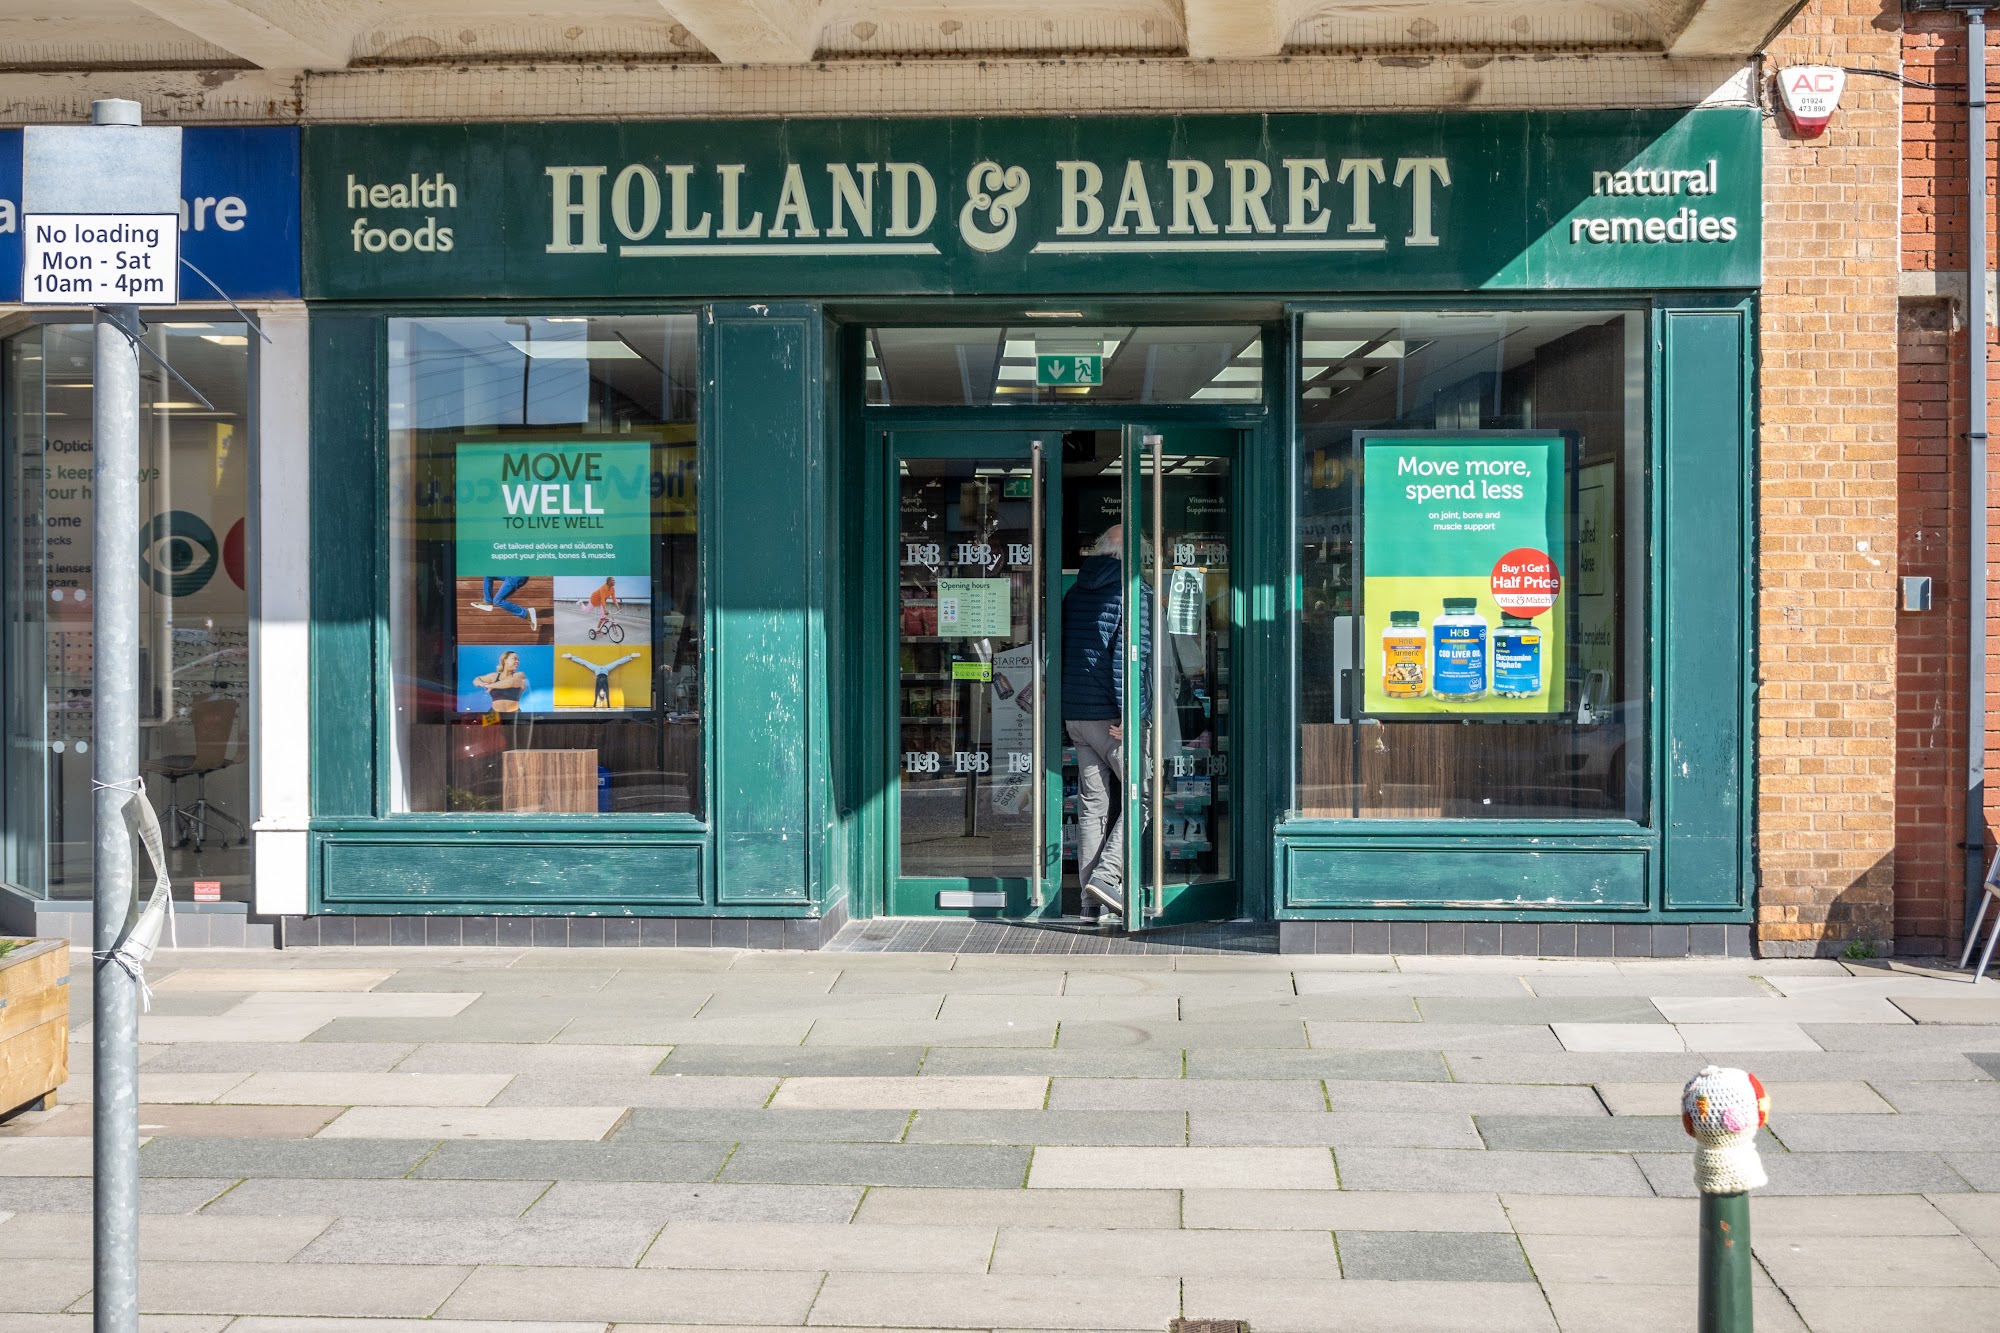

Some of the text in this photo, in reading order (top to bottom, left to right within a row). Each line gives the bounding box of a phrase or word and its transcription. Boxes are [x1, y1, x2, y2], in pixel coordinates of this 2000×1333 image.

[1791, 74, 1835, 92] AC
[1592, 159, 1718, 196] natural
[346, 172, 458, 209] health
[545, 157, 1452, 255] HOLLAND & BARRETT
[36, 223, 160, 247] No loading
[350, 216, 455, 253] foods
[1570, 207, 1738, 243] remedies
[42, 251, 93, 270] Mon
[115, 251, 152, 270] Sat
[33, 274, 93, 293] 10am
[114, 275, 164, 297] 4pm
[501, 452, 603, 481] MOVE
[1397, 456, 1532, 478] Move more,
[501, 483, 605, 515] WELL
[1405, 479, 1524, 504] spend less
[1186, 506, 1227, 515] Supplements
[1440, 511, 1461, 520] joint,
[1462, 511, 1484, 519] bone
[1484, 511, 1501, 519] and
[502, 516, 605, 529] TO LIVE WELL
[1433, 523, 1496, 532] muscle support
[491, 552, 519, 560] support
[519, 552, 535, 560] your
[535, 552, 557, 560] joints,
[493, 542, 507, 550] Get
[507, 542, 535, 550] tailored
[535, 542, 559, 550] advice
[559, 542, 573, 550] and
[573, 542, 605, 550] solutions
[906, 543, 941, 565] H&B
[1501, 563, 1550, 574] Buy 1 Get 1
[941, 581, 991, 591] Opening hours
[1492, 575, 1559, 588] Half Price
[1438, 649, 1451, 658] COD
[1451, 650, 1471, 658] LIVER
[1495, 653, 1532, 662] Glucosamine
[1495, 660, 1522, 669] Sulphate
[905, 751, 941, 773] H&B
[954, 751, 990, 773] H&B
